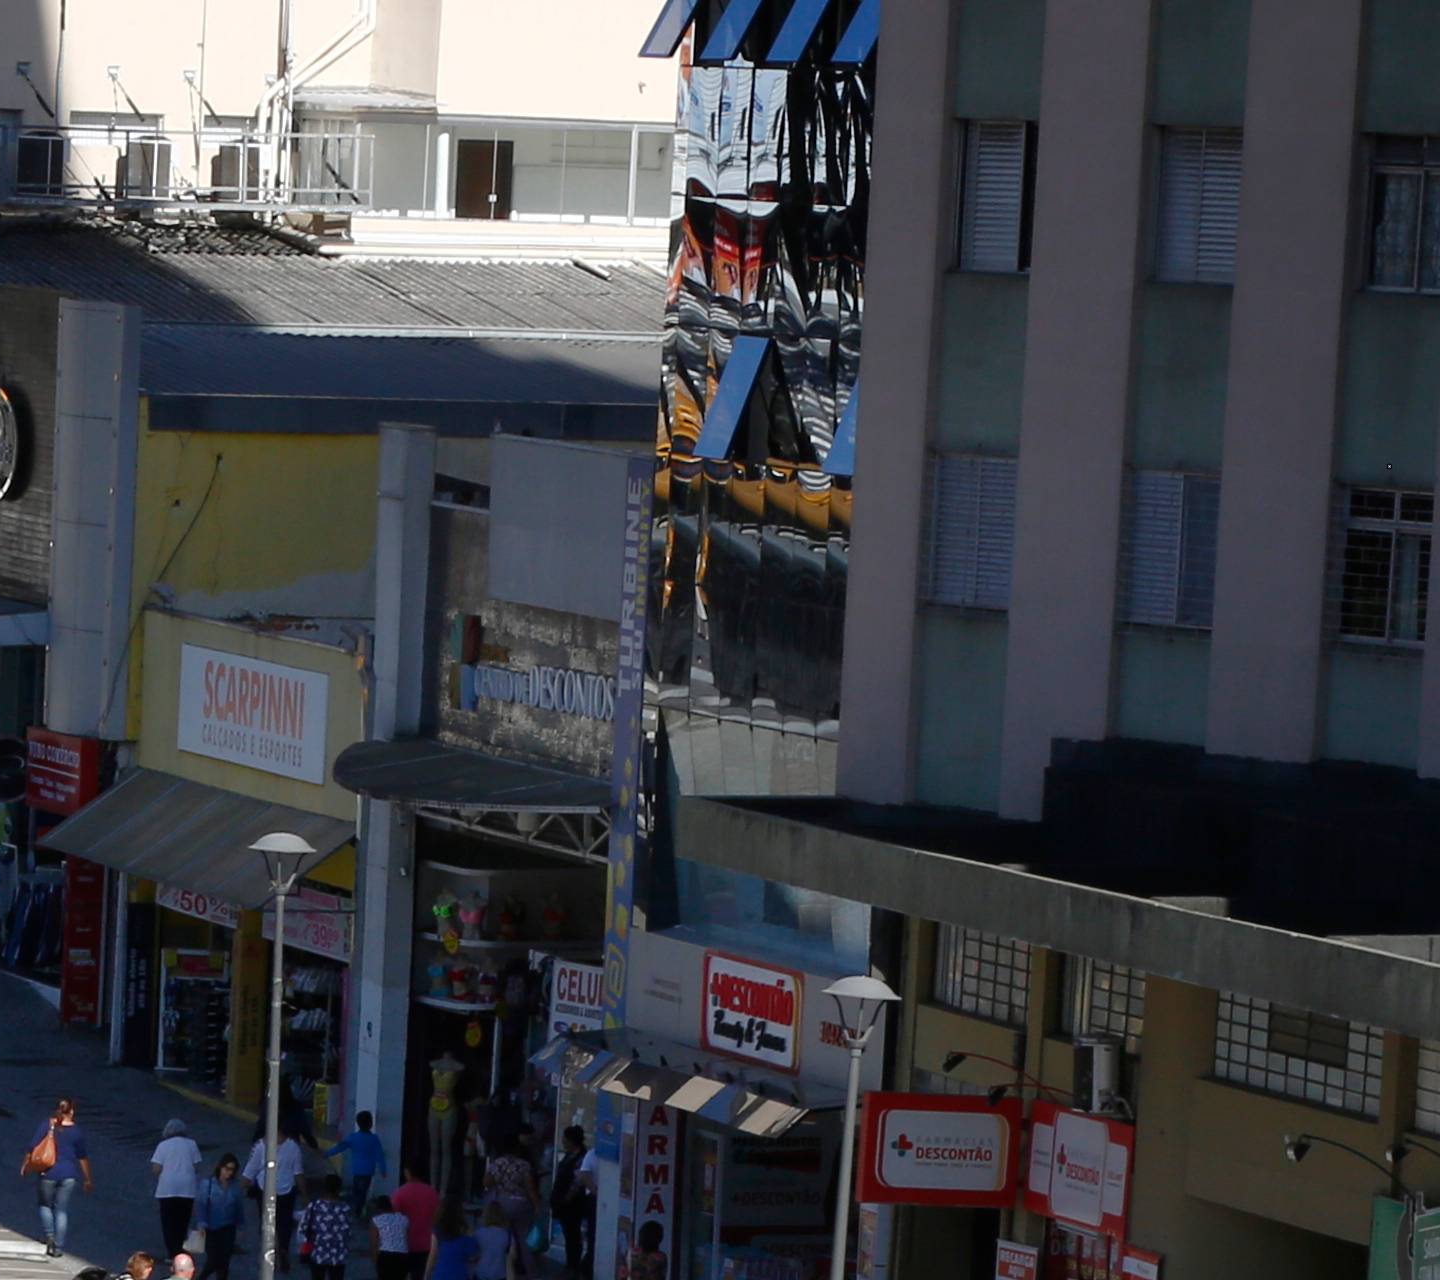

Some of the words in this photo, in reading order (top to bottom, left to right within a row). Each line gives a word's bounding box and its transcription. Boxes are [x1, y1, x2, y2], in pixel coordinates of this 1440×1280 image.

[617, 476, 642, 699] TURBINE
[203, 660, 304, 742] SCARPINNI
[530, 664, 615, 723] DESCONTOS
[915, 1144, 993, 1164] DESCONTÃO
